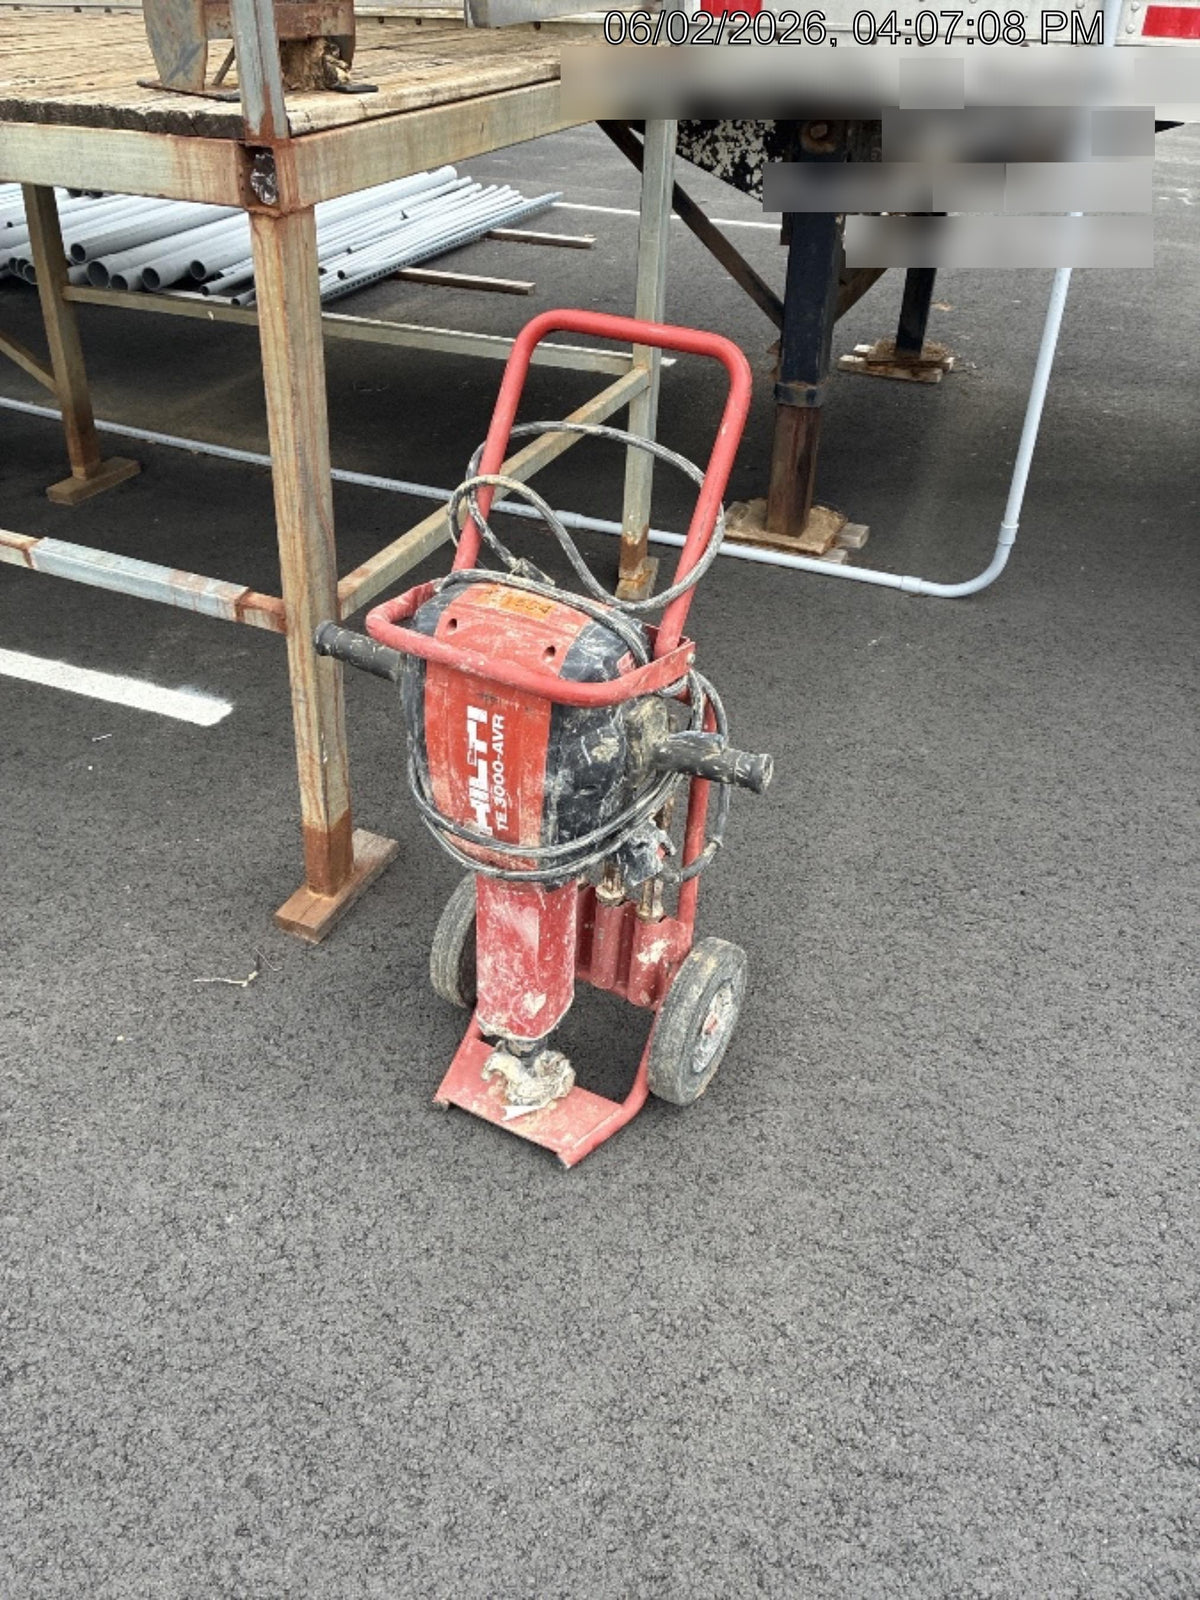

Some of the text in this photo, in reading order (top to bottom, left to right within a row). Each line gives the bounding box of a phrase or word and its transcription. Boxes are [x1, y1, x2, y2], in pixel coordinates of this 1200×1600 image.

[466, 704, 493, 836] HILTI
[491, 712, 508, 808] 3000-AVR
[495, 810, 510, 832] TE
